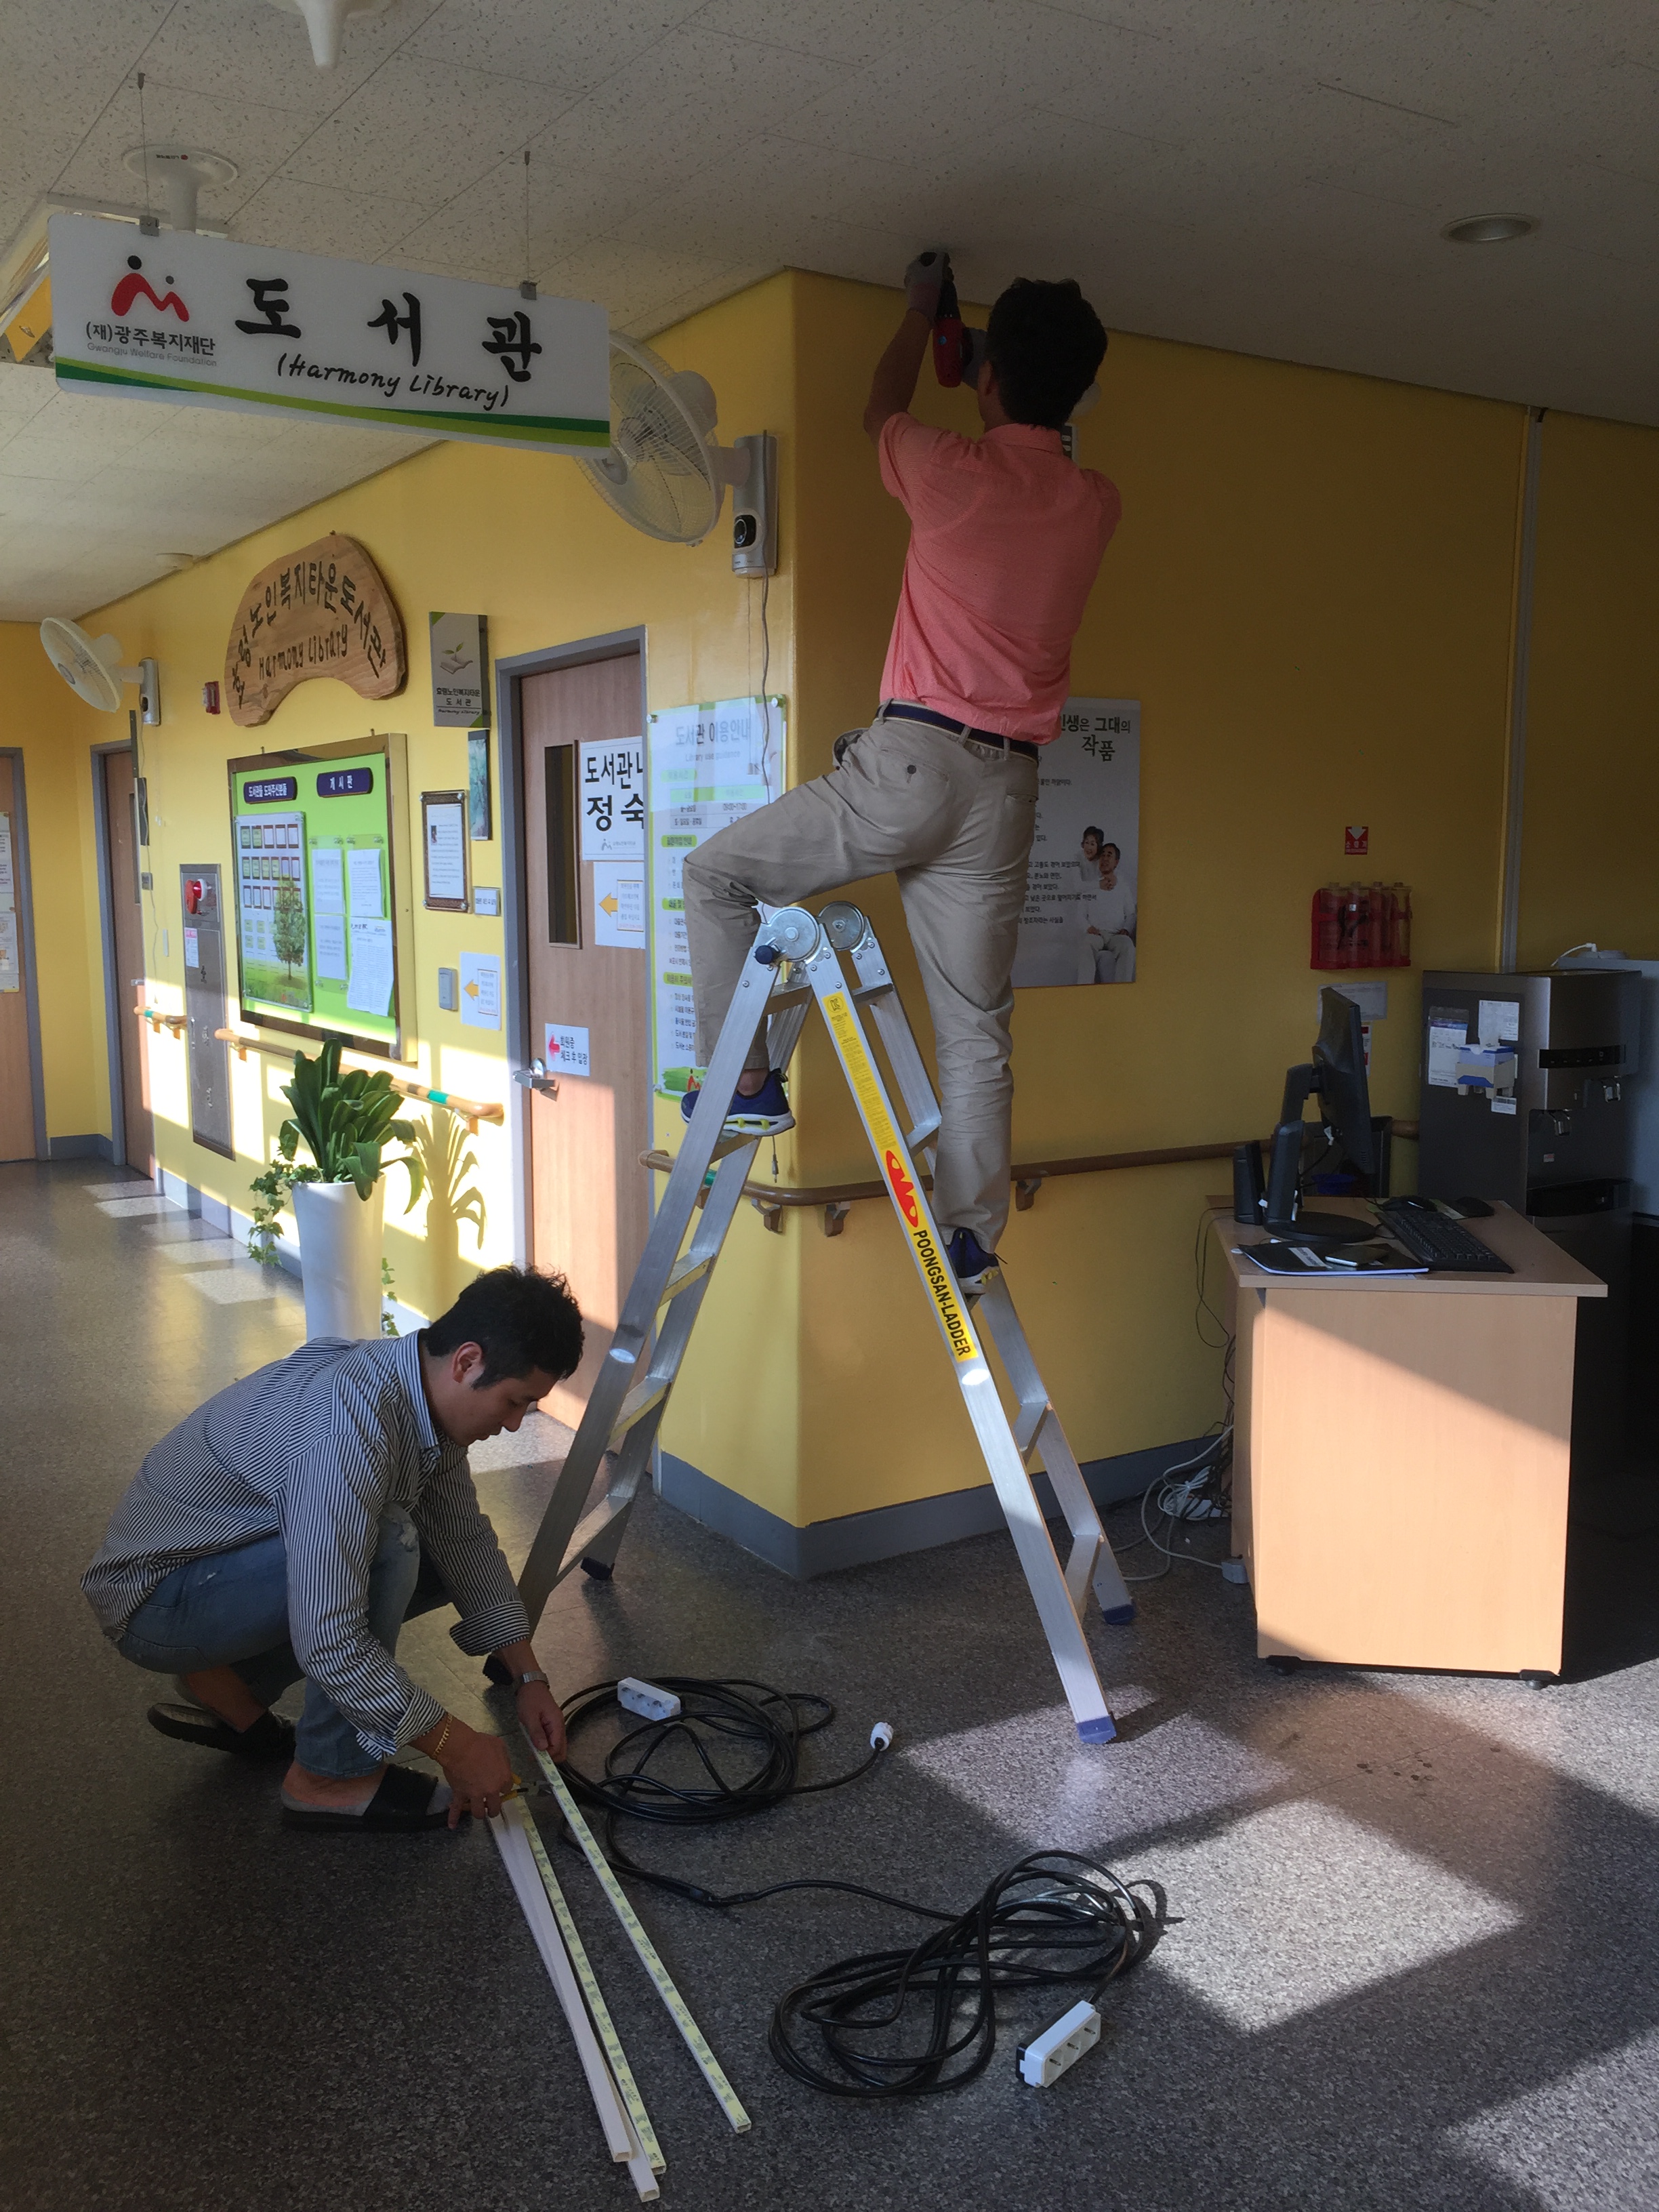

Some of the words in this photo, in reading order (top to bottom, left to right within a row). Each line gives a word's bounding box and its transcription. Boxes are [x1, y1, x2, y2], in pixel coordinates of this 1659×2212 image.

[86, 321, 217, 356] (재)광주복지재단
[234, 278, 543, 382] 도서관
[87, 342, 128, 355] Gwangju
[129, 348, 165, 360] Welfare
[167, 352, 217, 367] Foundation
[278, 352, 401, 398] (Harmony
[409, 375, 509, 411] Library)
[676, 723, 705, 745] 도서관
[1094, 716, 1131, 735] 그대의
[1082, 734, 1116, 762] 작품
[913, 1229, 971, 1357] POONGSAN-LADDER
